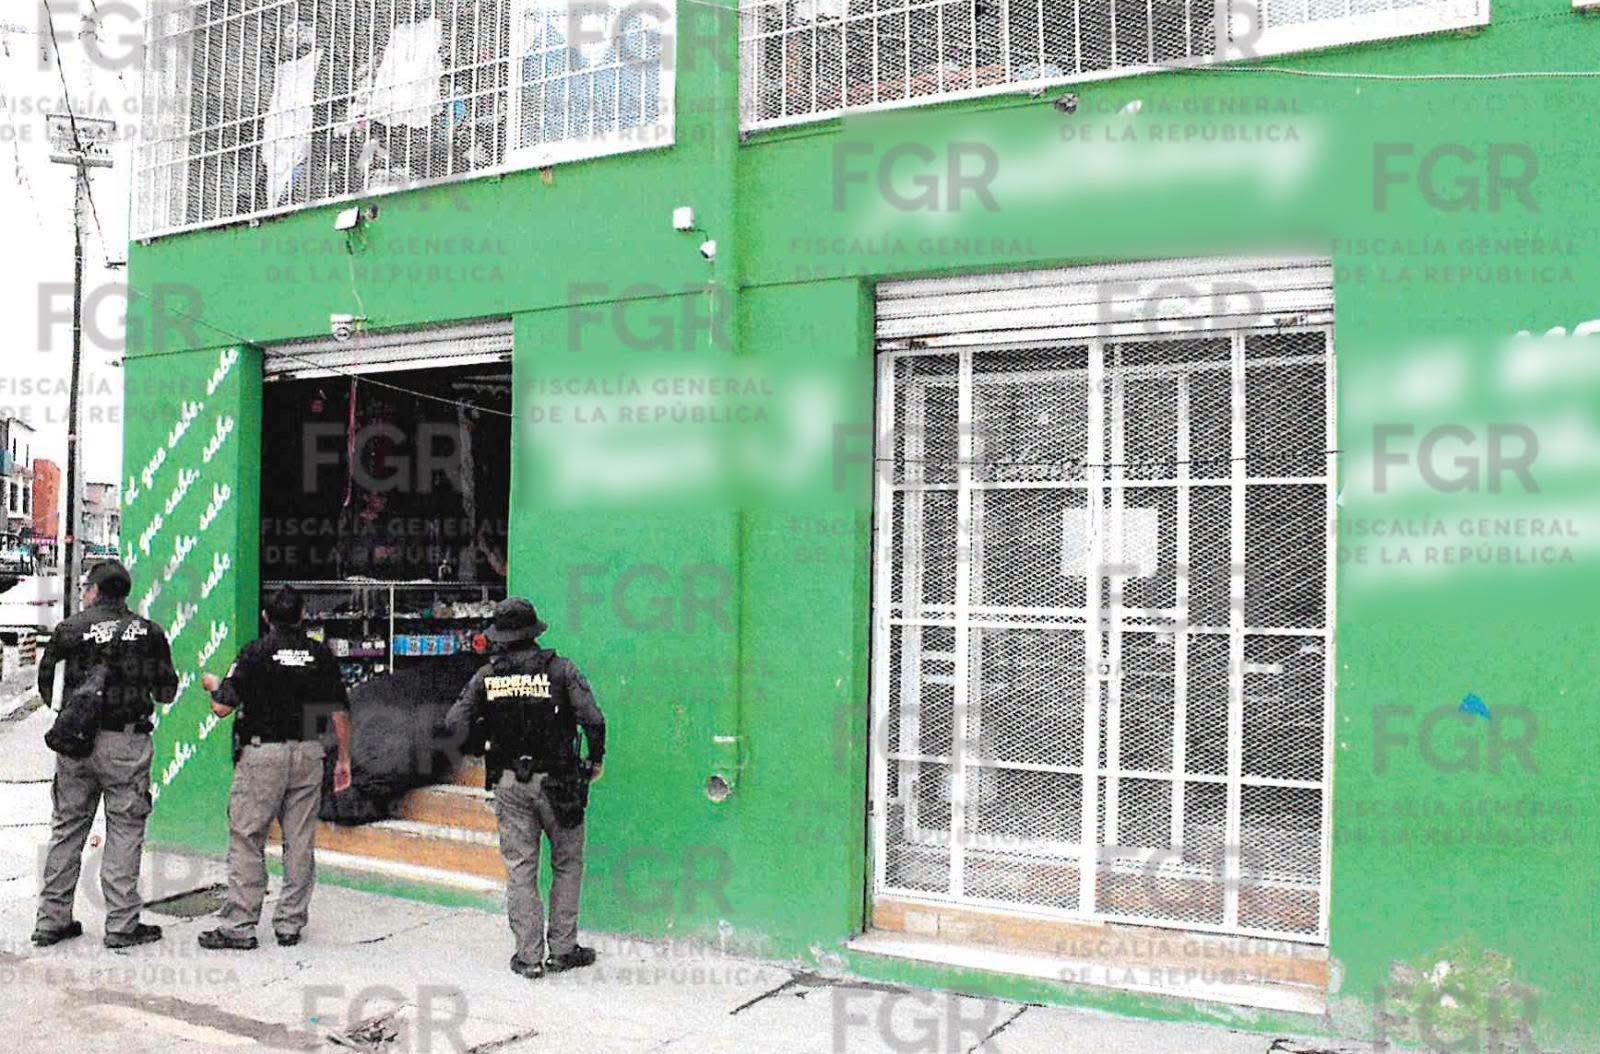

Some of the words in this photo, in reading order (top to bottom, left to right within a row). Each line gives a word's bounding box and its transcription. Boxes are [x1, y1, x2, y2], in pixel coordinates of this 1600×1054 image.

[206, 348, 239, 396] sabe
[202, 415, 234, 463] sabe
[199, 482, 231, 532] sabe
[201, 551, 231, 599] sabe
[197, 620, 229, 668] sabe
